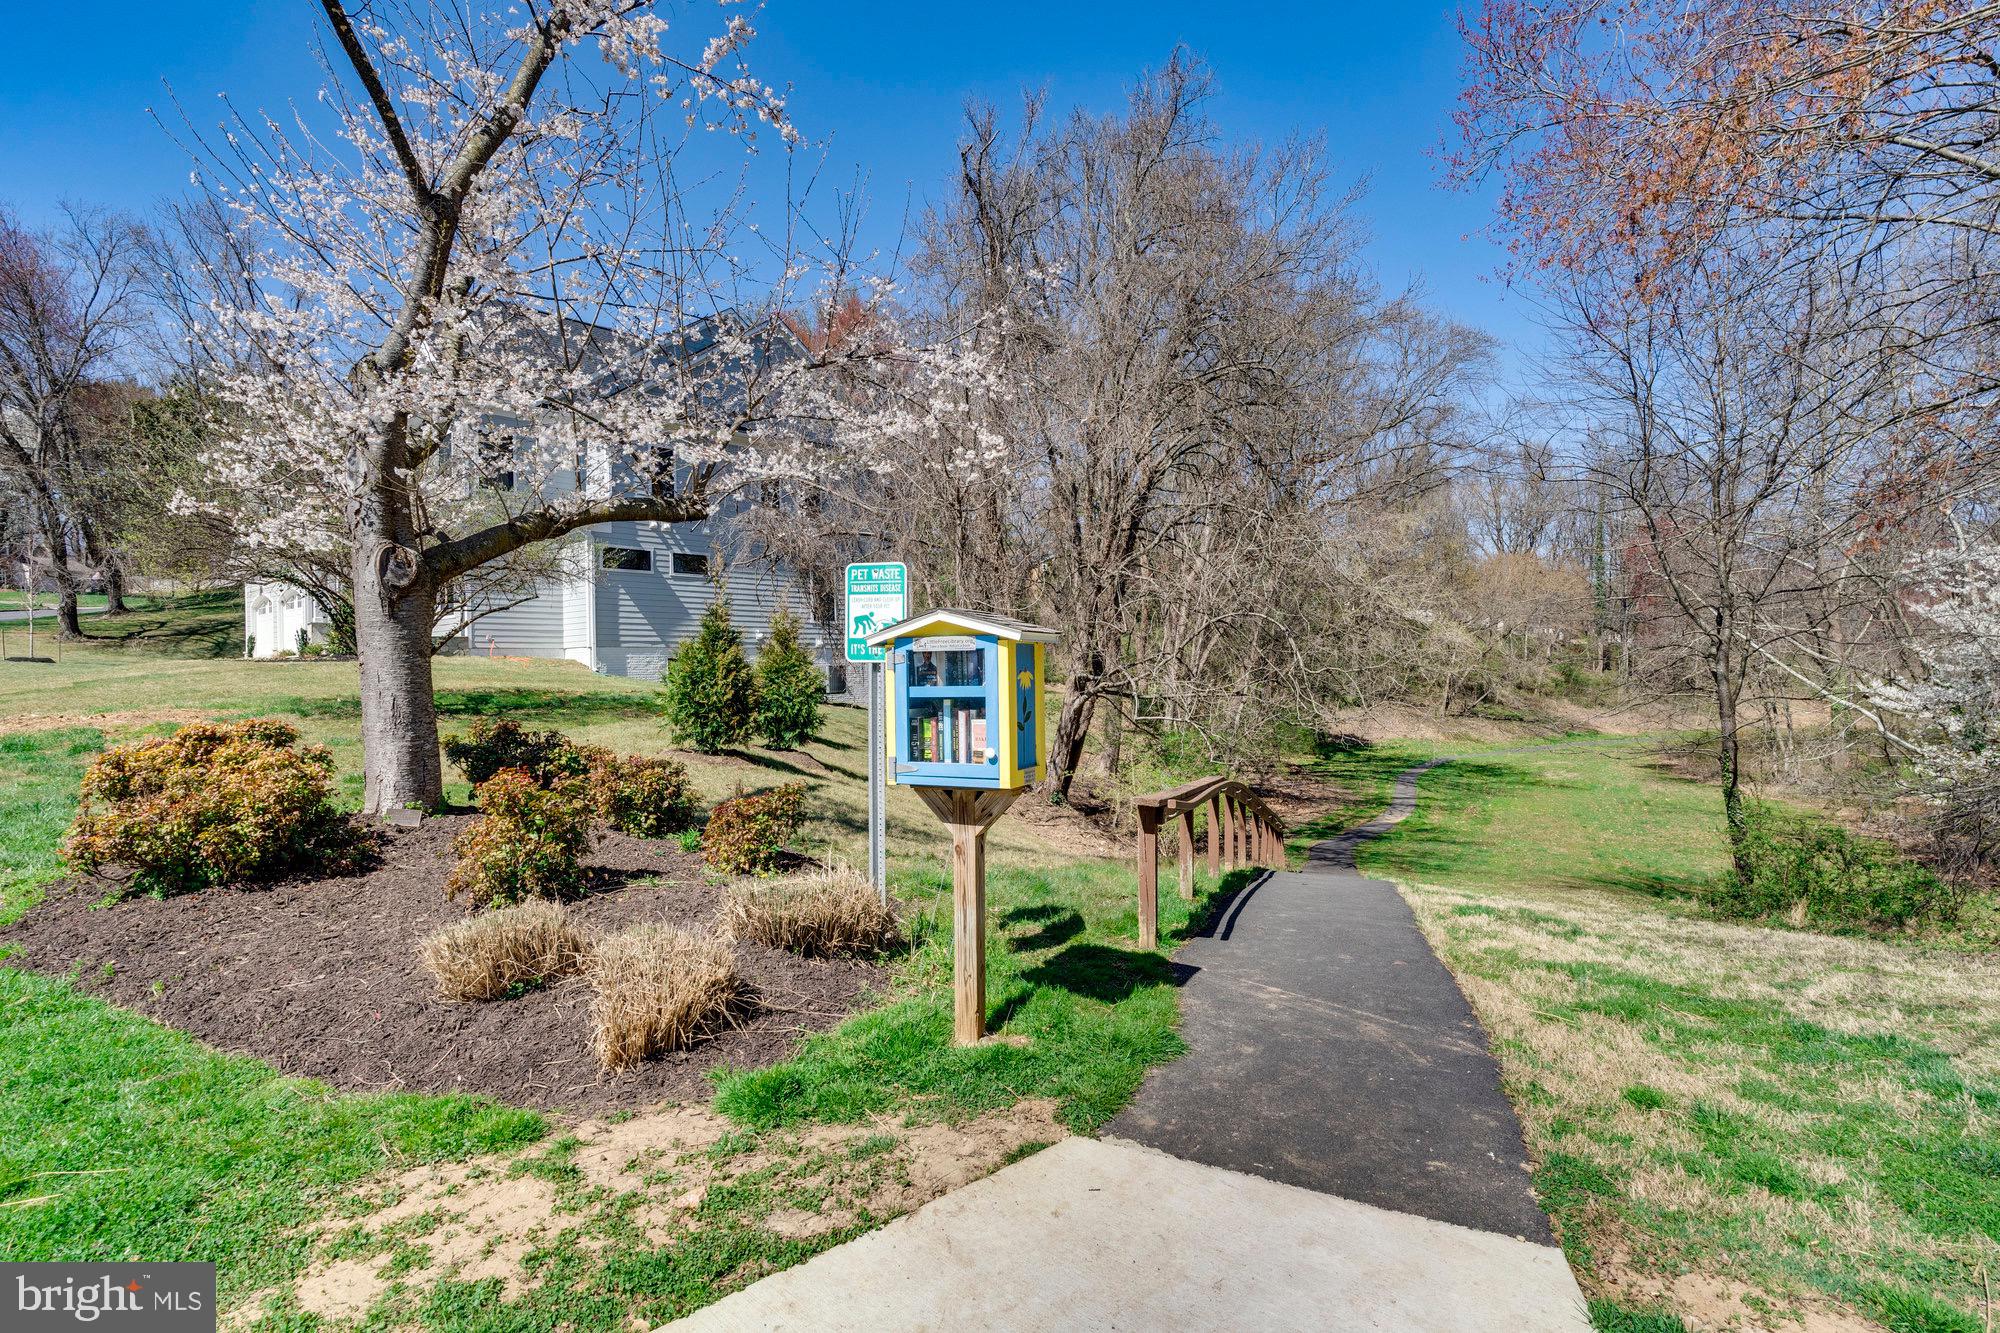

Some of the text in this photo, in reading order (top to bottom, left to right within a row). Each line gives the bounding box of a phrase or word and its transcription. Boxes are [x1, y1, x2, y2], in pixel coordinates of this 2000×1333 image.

[851, 568, 901, 581] PET WASTE
[851, 583, 901, 593] TRANSMITS DISEASE
[850, 644, 866, 655] IT'S
